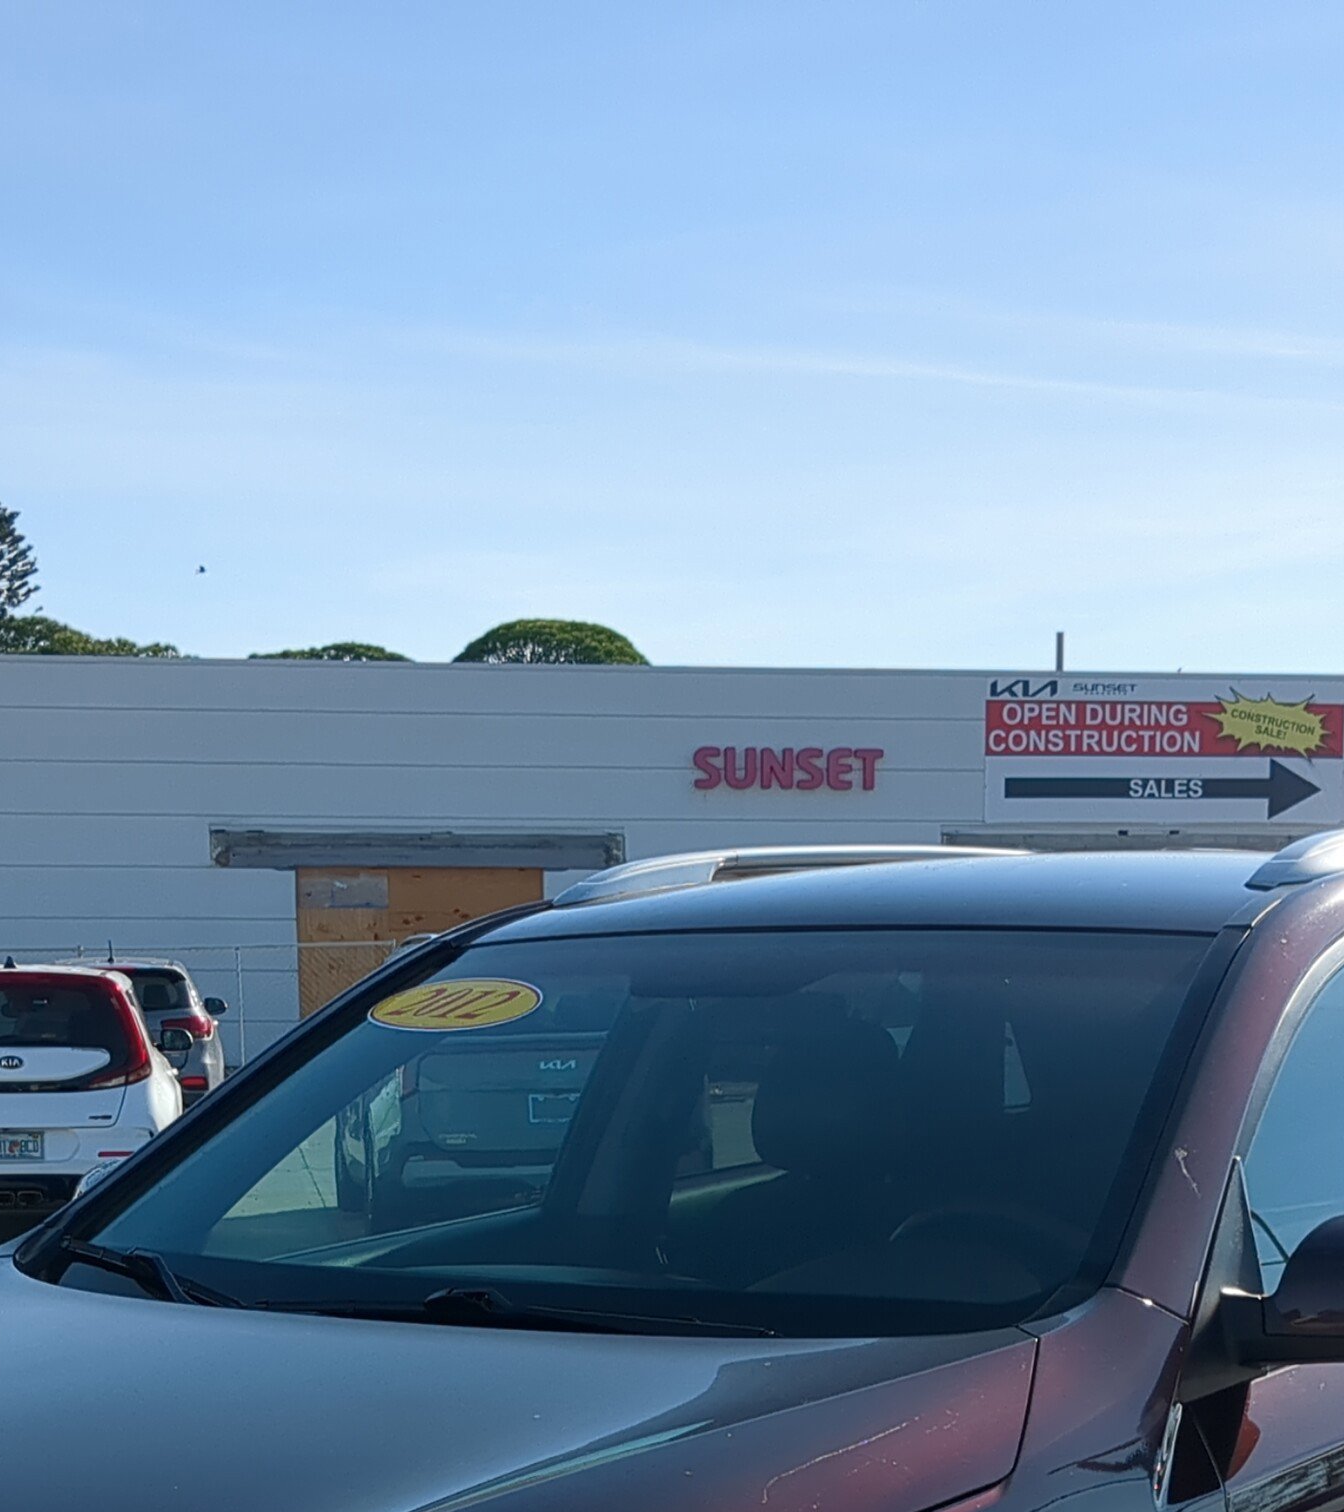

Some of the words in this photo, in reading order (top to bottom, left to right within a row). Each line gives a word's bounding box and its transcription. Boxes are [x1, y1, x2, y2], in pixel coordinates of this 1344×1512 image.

[990, 679, 1059, 698] KIA
[1002, 703, 1077, 726] OPEN
[1085, 704, 1189, 727] DURING
[1231, 708, 1317, 736] CONSTRUCTION
[988, 729, 1201, 753] CONSTRUCTION
[1254, 724, 1287, 741] SALE!
[693, 746, 885, 791] SUNSET
[1129, 779, 1204, 799] SALES
[382, 987, 521, 1020] 2012
[0, 1056, 21, 1067] KIA
